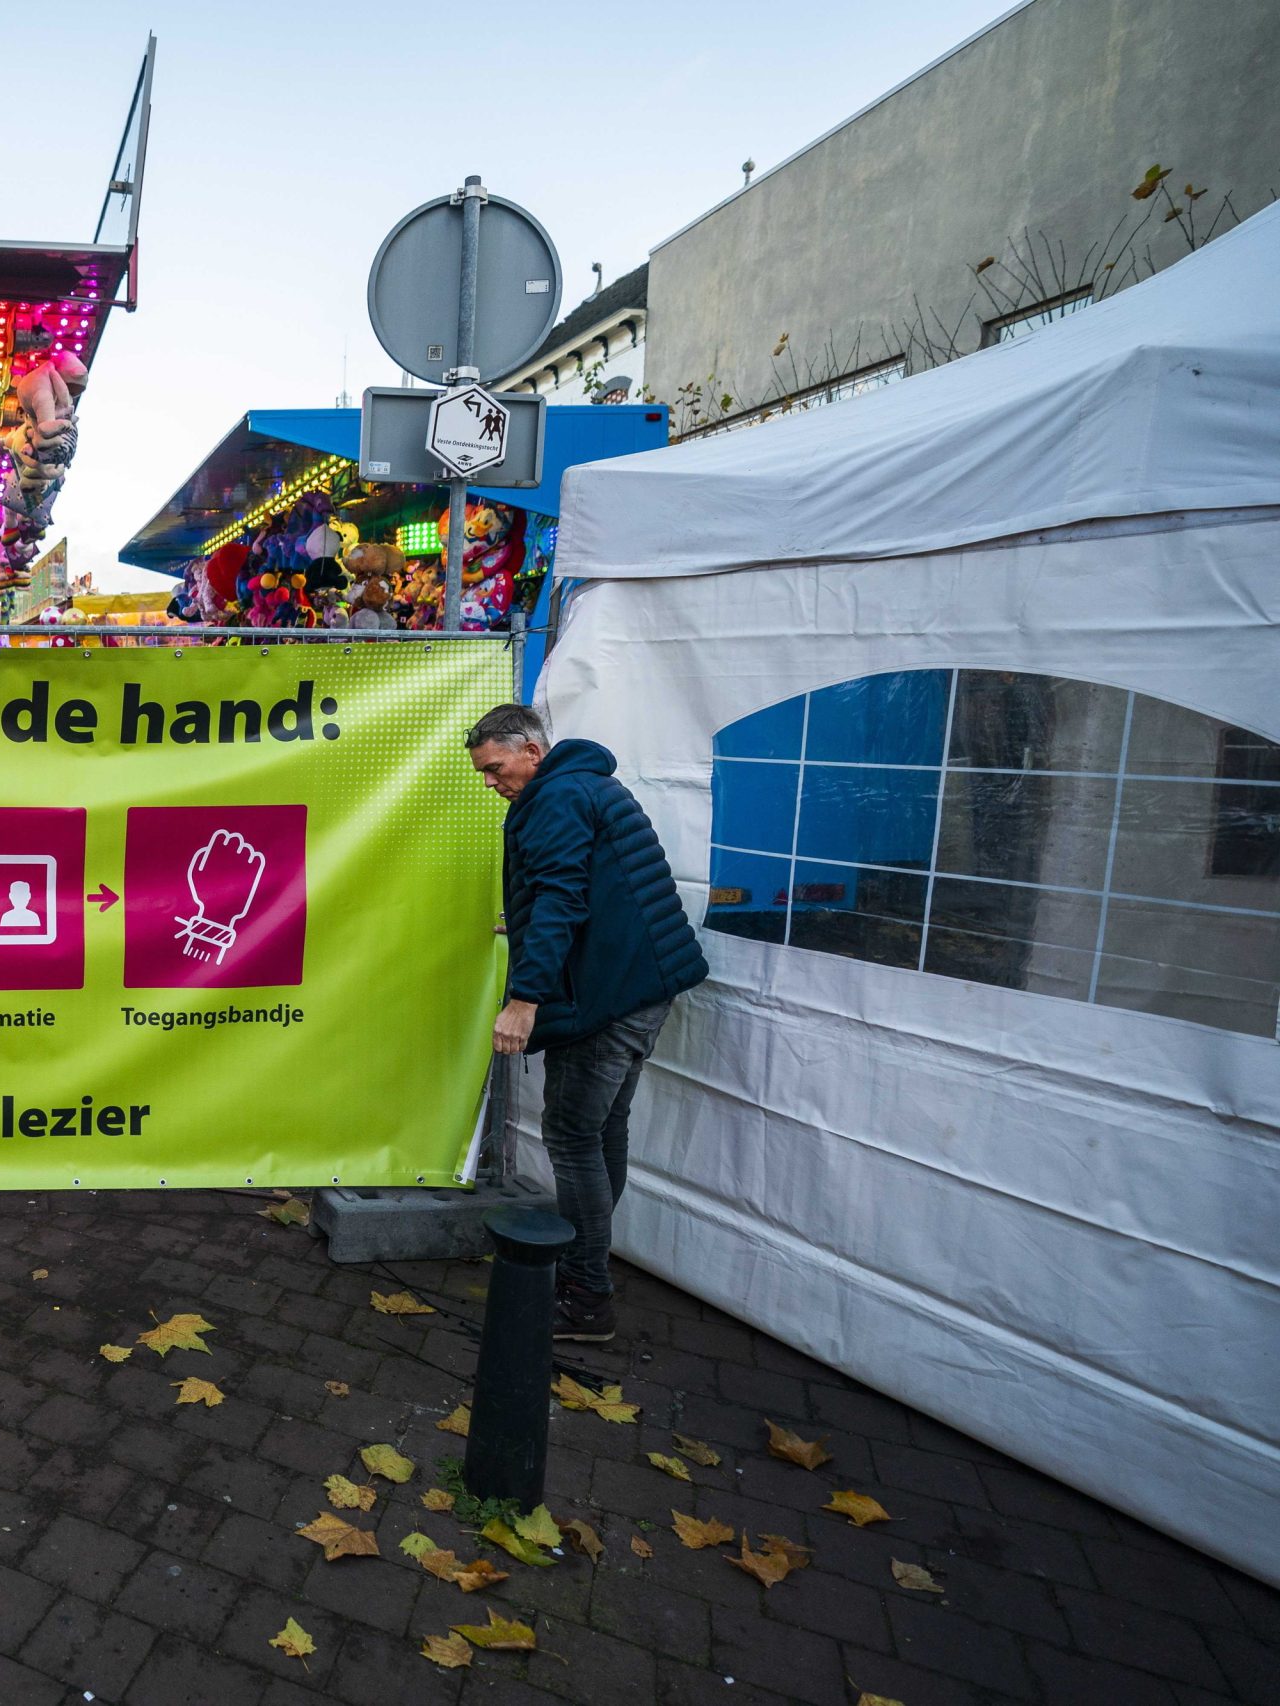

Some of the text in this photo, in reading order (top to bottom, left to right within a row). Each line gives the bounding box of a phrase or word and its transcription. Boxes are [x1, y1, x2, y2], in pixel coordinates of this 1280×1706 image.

[452, 440, 499, 451] Ontdekkingstocht
[0, 680, 98, 744] de
[119, 680, 341, 745] hand:
[120, 1003, 304, 1031] Toegangsbandje
